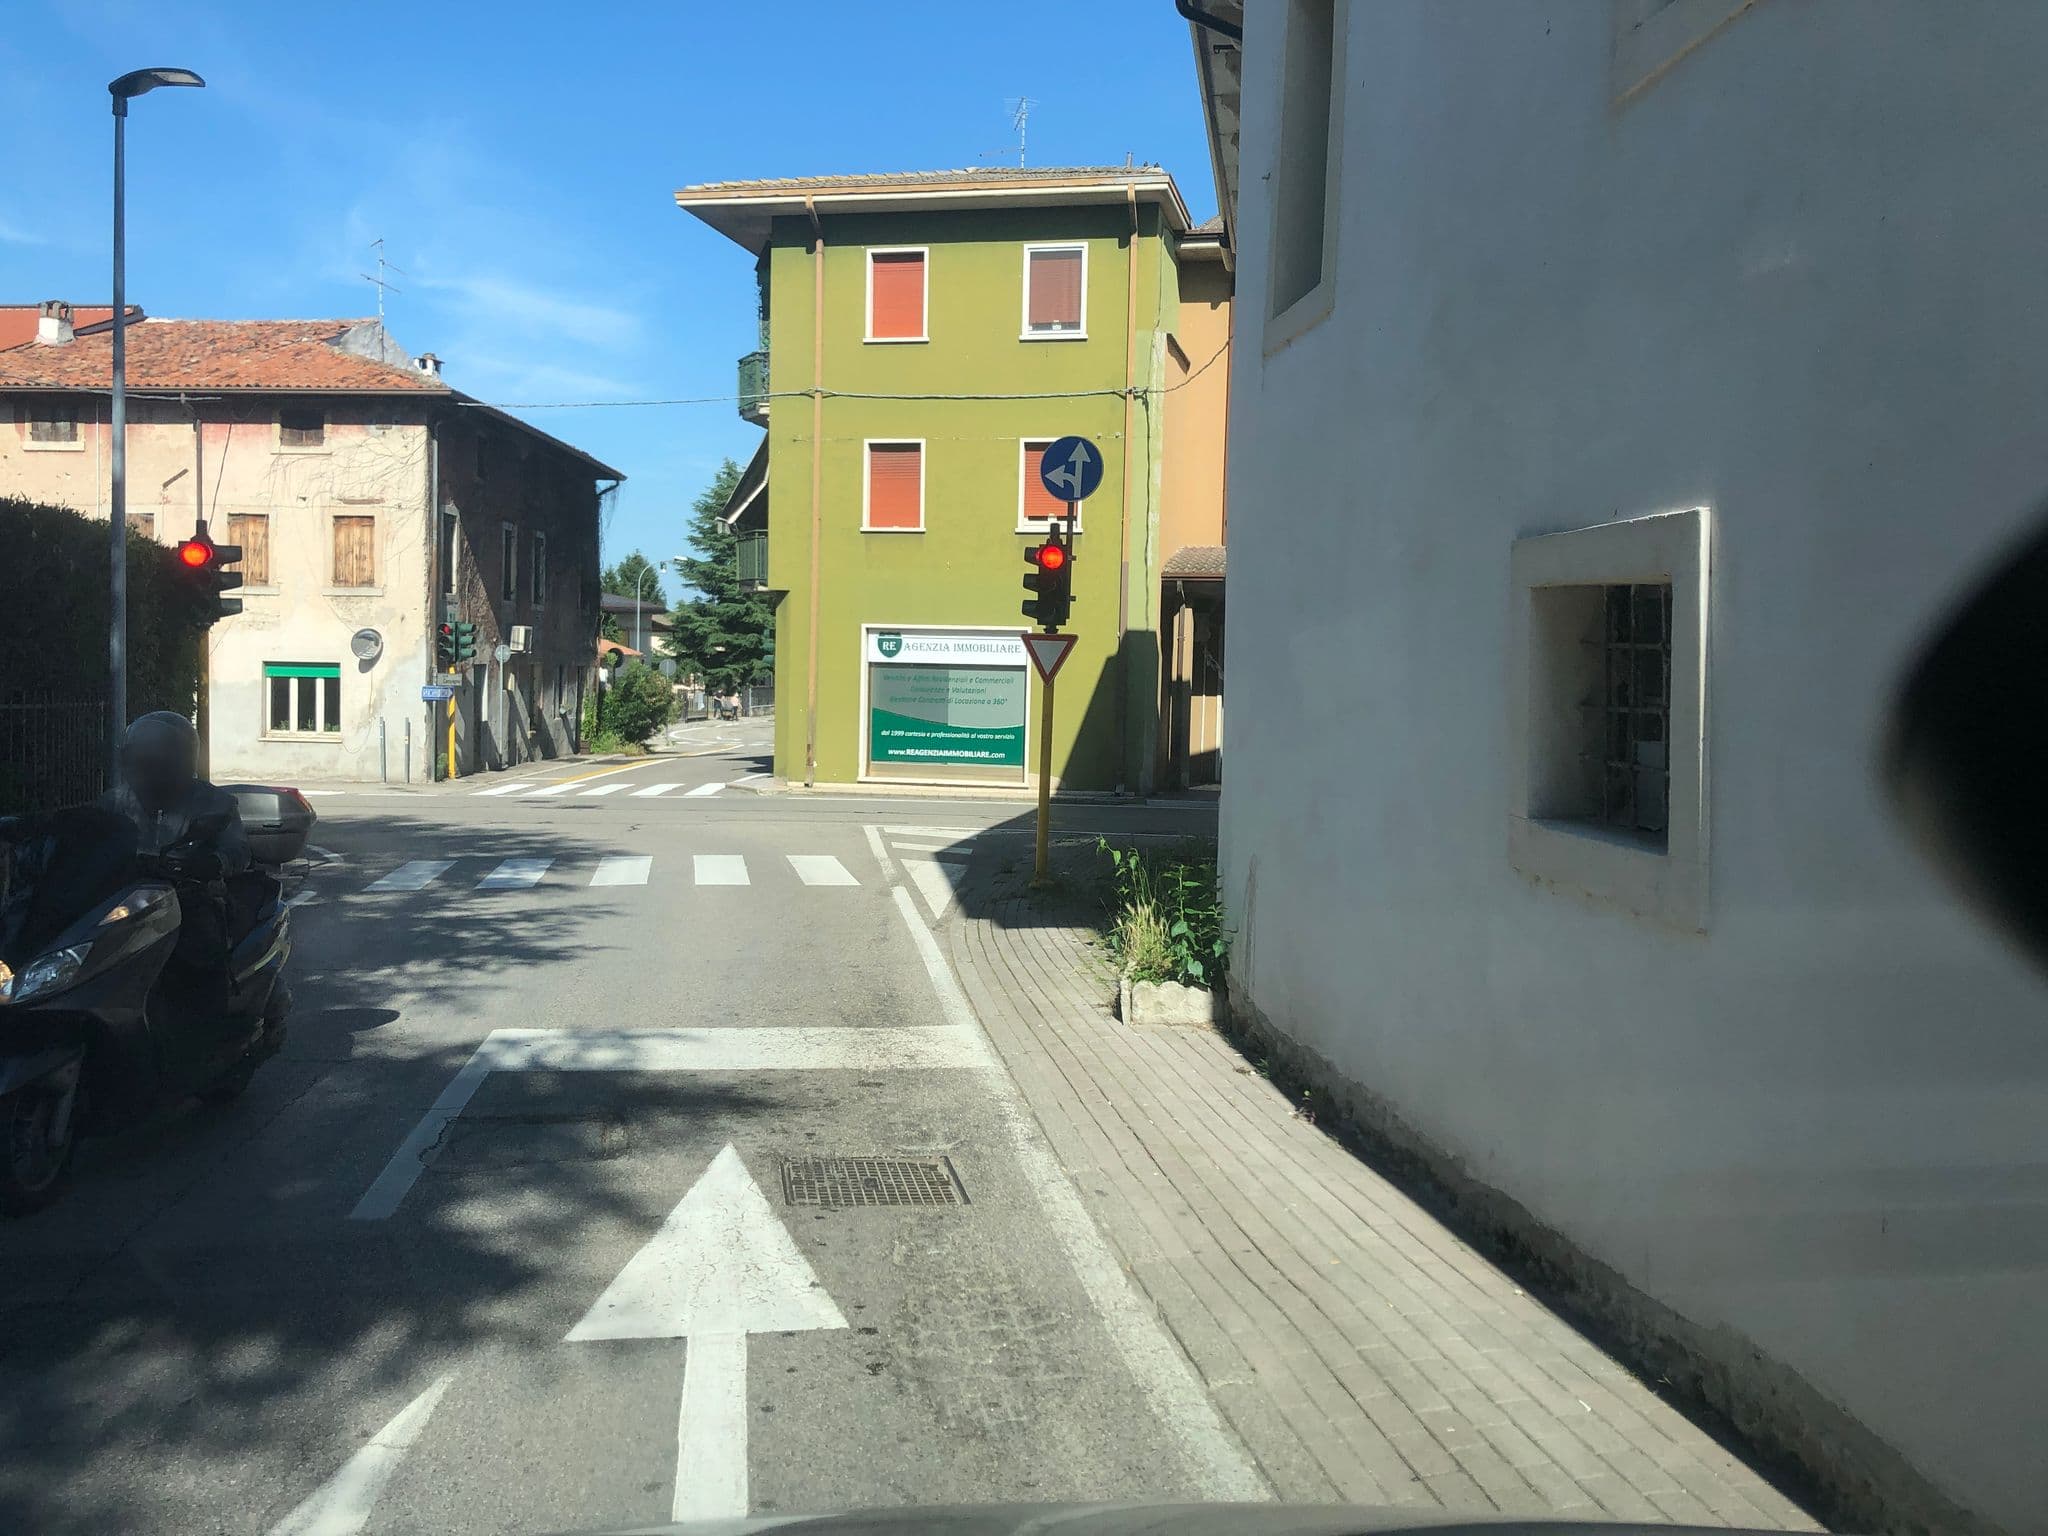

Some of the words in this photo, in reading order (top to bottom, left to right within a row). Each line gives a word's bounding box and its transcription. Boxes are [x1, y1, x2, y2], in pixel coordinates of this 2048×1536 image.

[882, 641, 897, 651] RE
[904, 642, 950, 652] AGENZIA
[953, 643, 1022, 653] IMMOBILIARE
[974, 676, 1014, 684] Commerciali
[952, 686, 987, 694] Valutazioni
[888, 748, 1006, 759] www.REAGENZIAIMMOBILIARE.com
